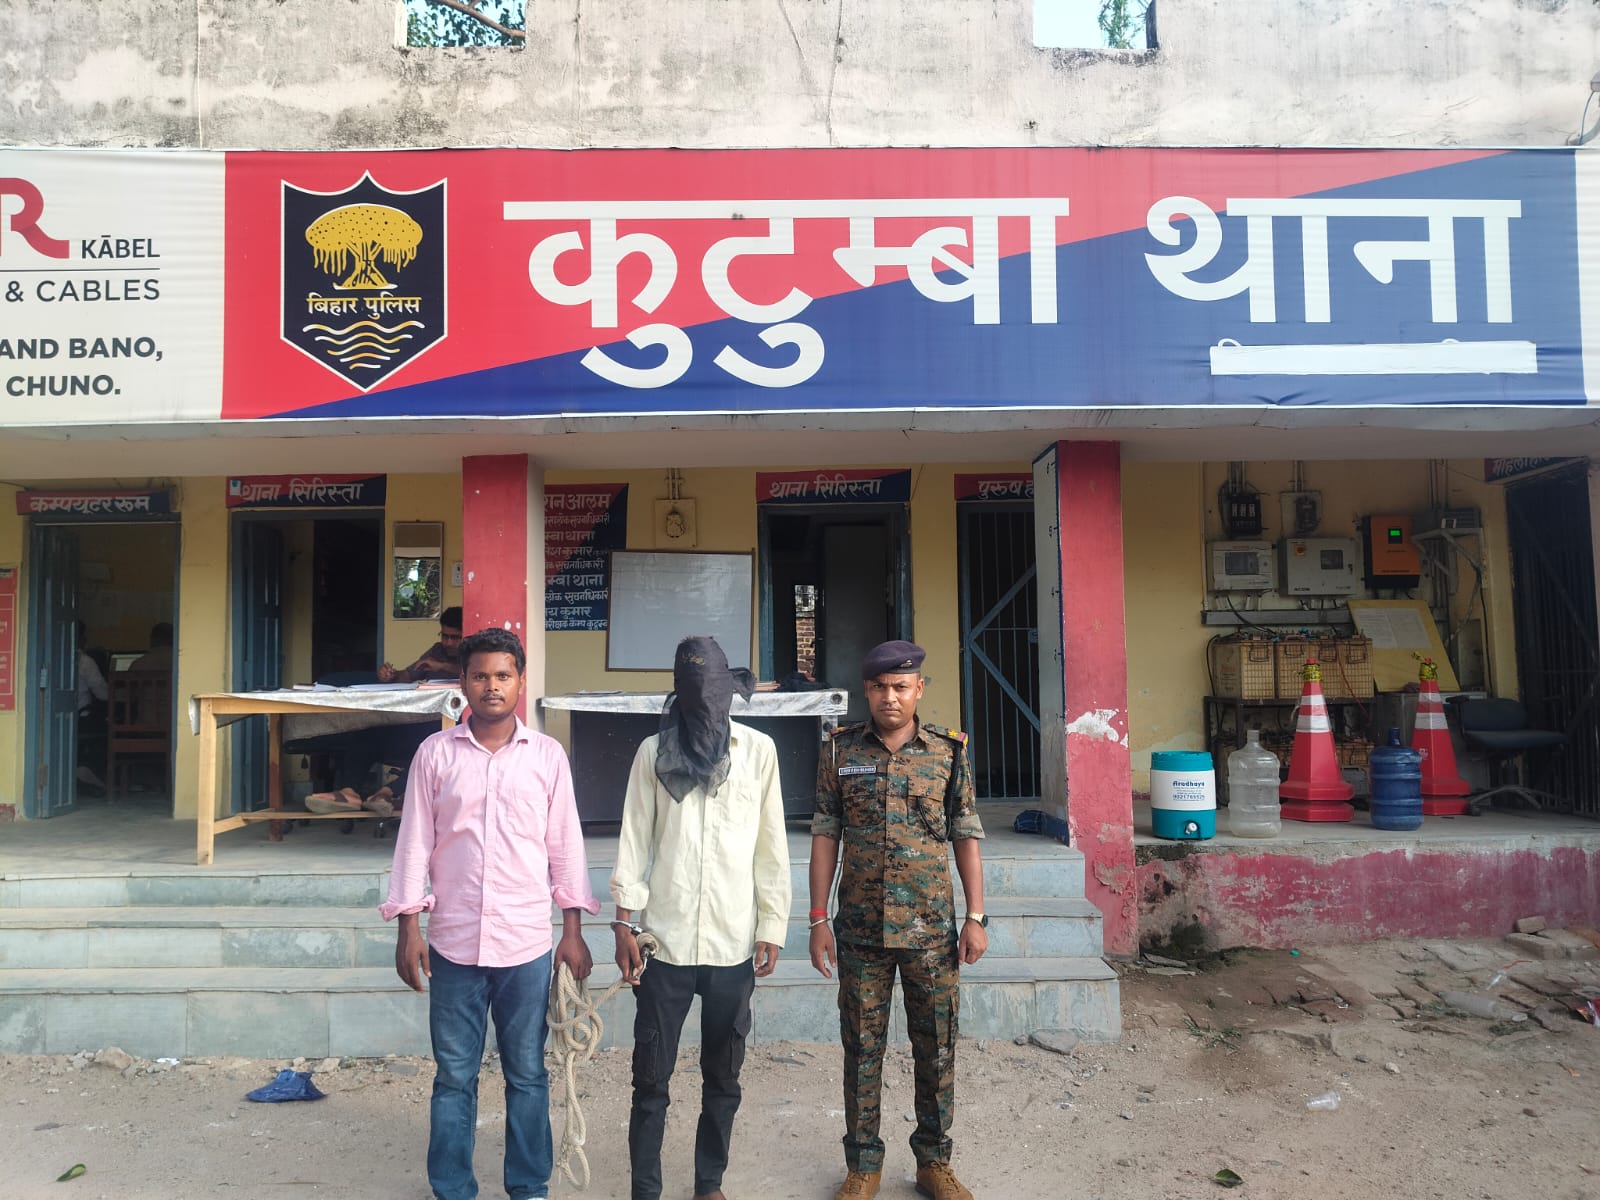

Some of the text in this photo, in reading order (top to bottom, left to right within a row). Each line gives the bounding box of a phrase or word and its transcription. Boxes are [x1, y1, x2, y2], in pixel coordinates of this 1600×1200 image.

[81, 236, 161, 259] KĀBEL
[5, 278, 161, 302] & CABLES
[503, 195, 1522, 390] कुटुम्बा थाना
[306, 291, 422, 319] बिहार पुलिस
[69, 337, 163, 361] BANO,
[6, 375, 121, 396] CHUNO.
[241, 484, 282, 501] थाना
[769, 481, 809, 498] थाना
[573, 574, 604, 588] थाना
